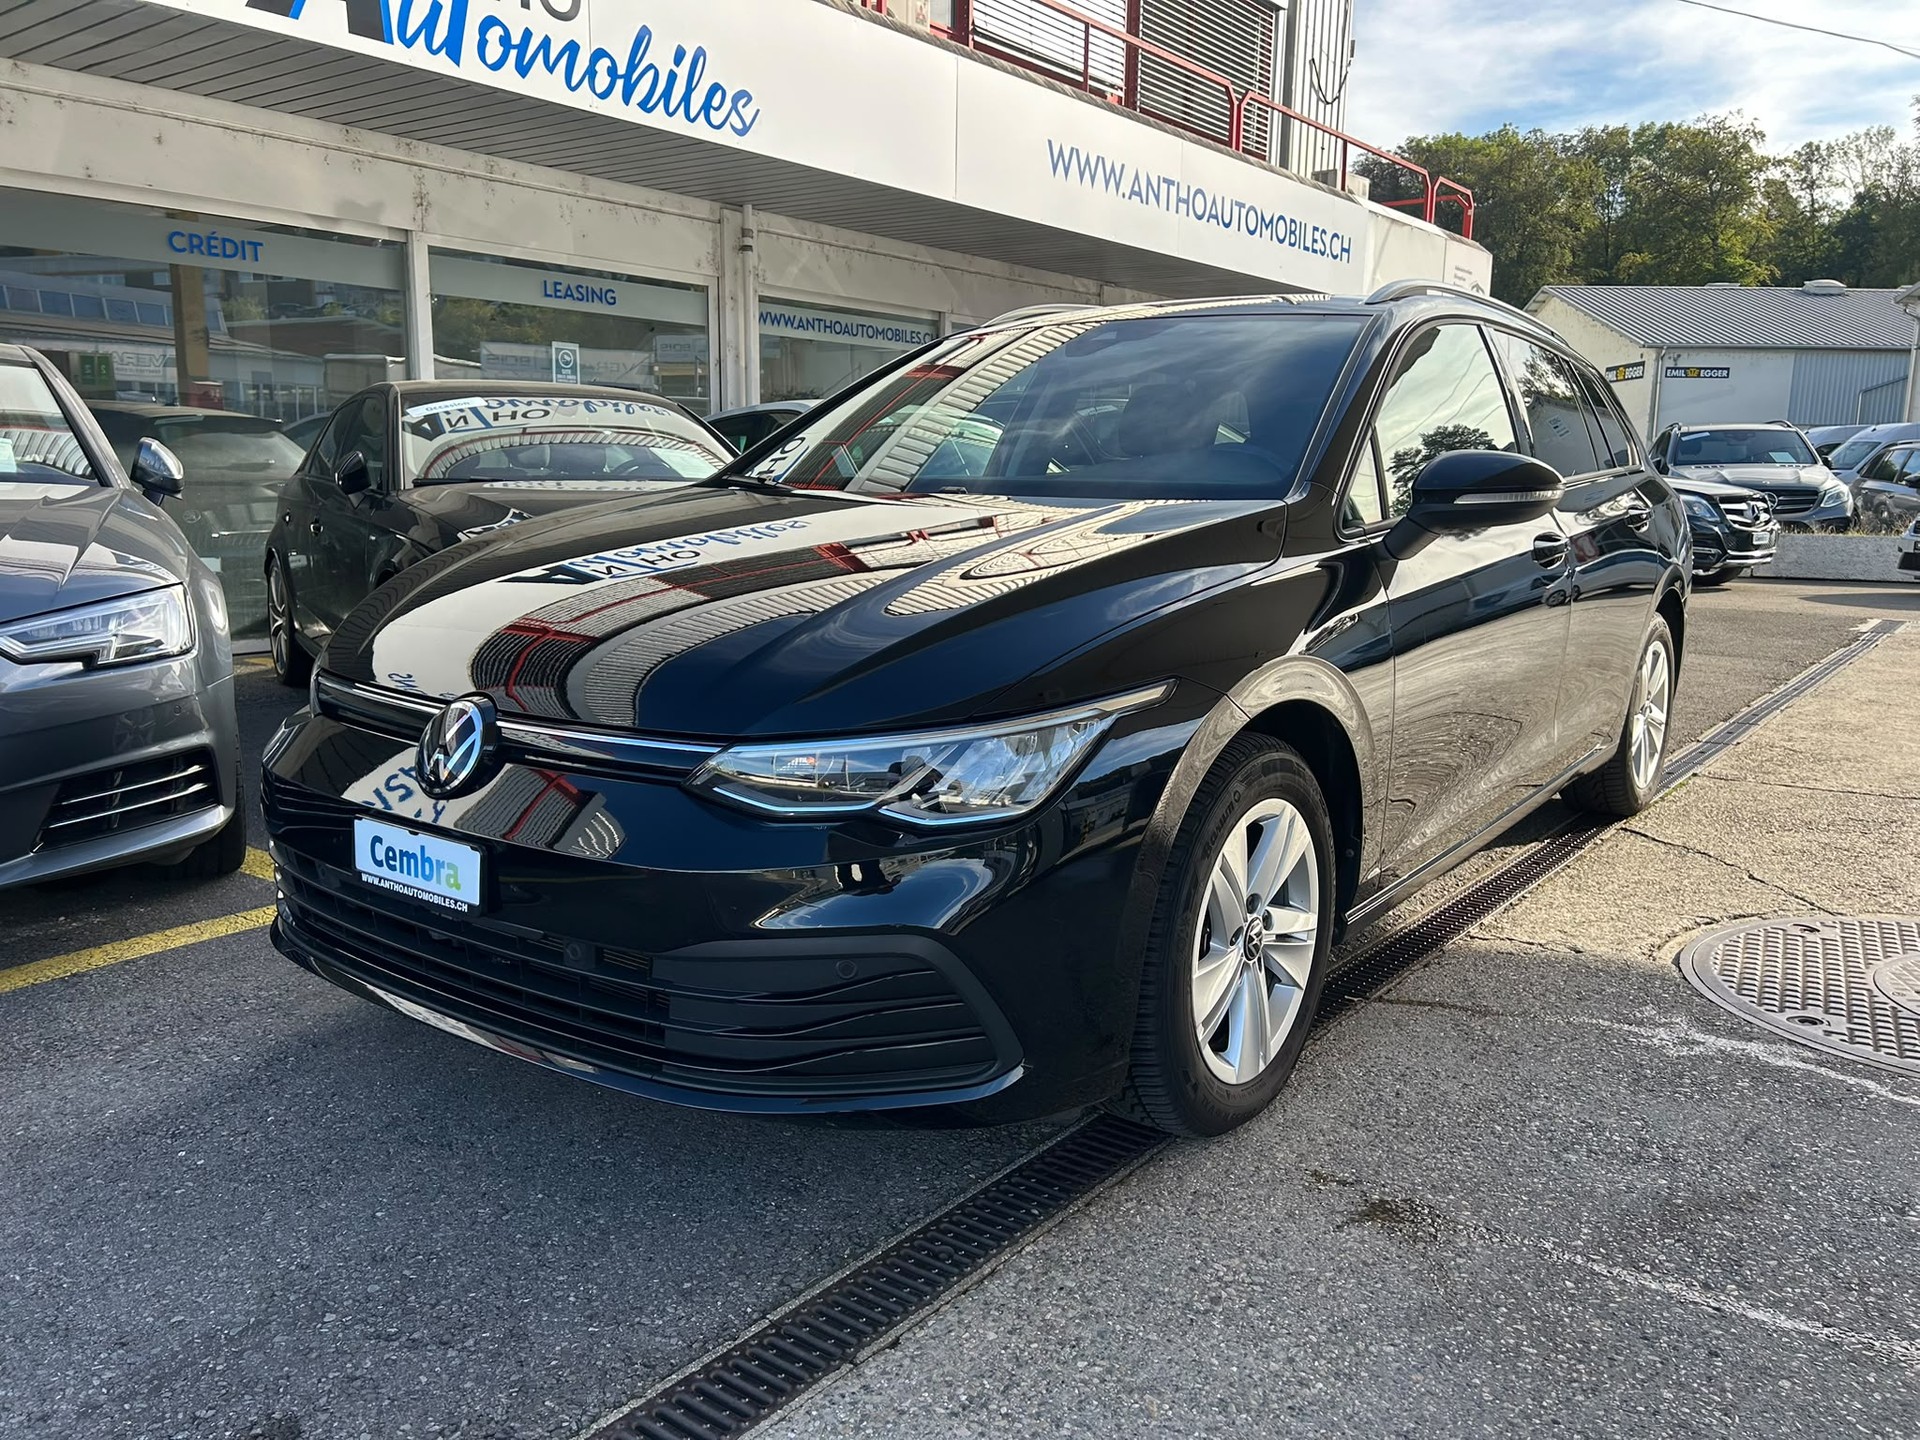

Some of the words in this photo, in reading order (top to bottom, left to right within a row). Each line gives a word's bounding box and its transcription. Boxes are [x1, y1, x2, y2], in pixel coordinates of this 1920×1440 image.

[1047, 139, 1352, 264] WWW.ANTHOAUTOMOBILES.CH
[167, 231, 264, 263] CRÉDIT
[543, 280, 617, 306] LEASING
[369, 834, 462, 892] Cembra
[361, 872, 468, 913] WWW.ANTHOAUTOMOBILES.CH
